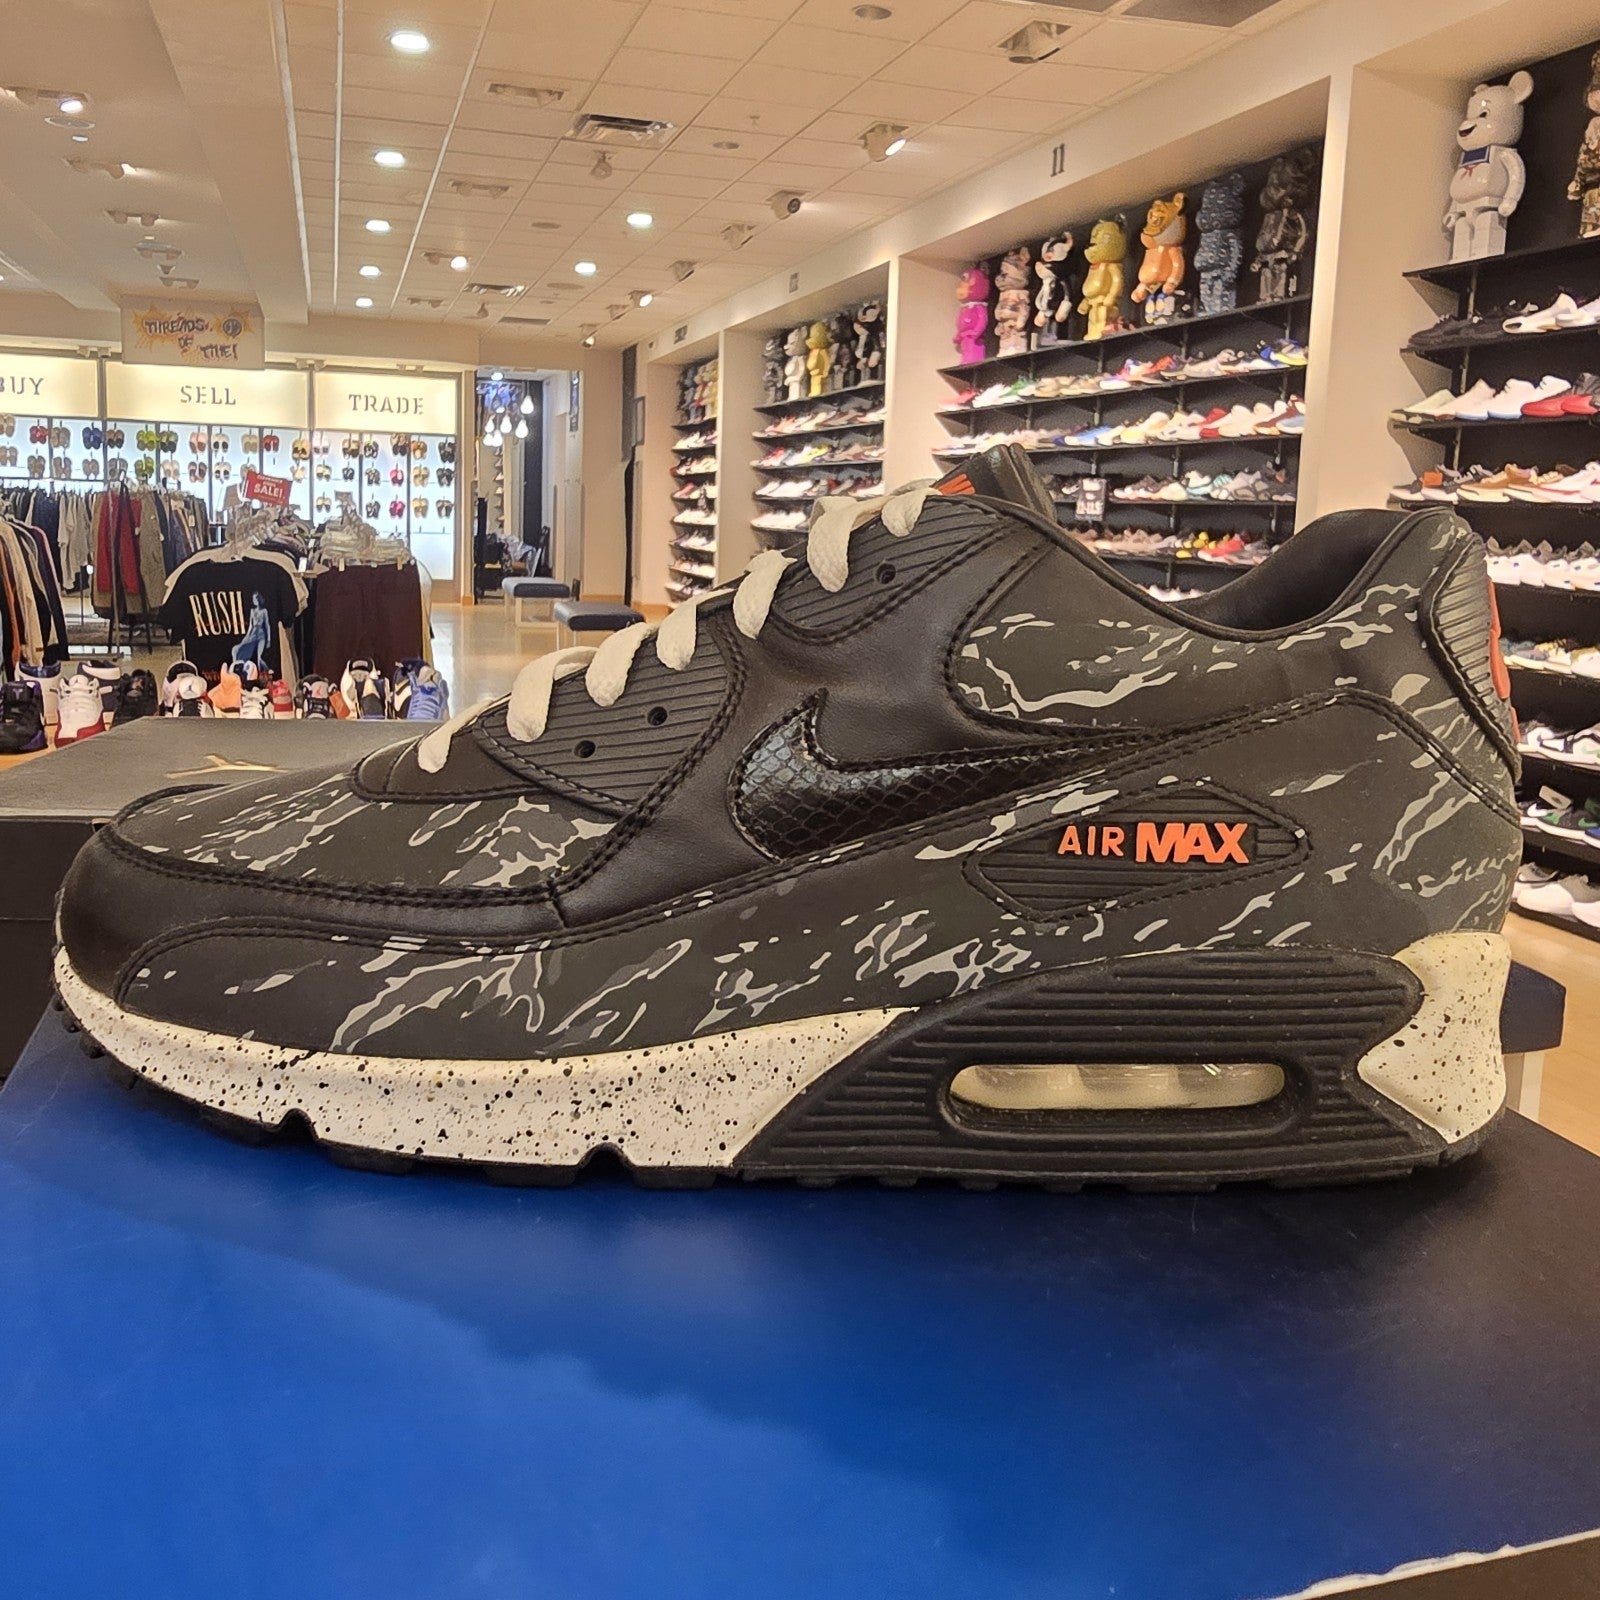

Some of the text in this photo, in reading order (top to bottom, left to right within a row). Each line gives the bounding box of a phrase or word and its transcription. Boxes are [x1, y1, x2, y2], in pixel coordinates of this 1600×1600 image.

[144, 316, 206, 334] THREADS
[180, 385, 236, 406] SELL
[349, 394, 424, 415] TRADE
[189, 591, 246, 637] RUSH
[1057, 822, 1249, 864] AIR MAX
